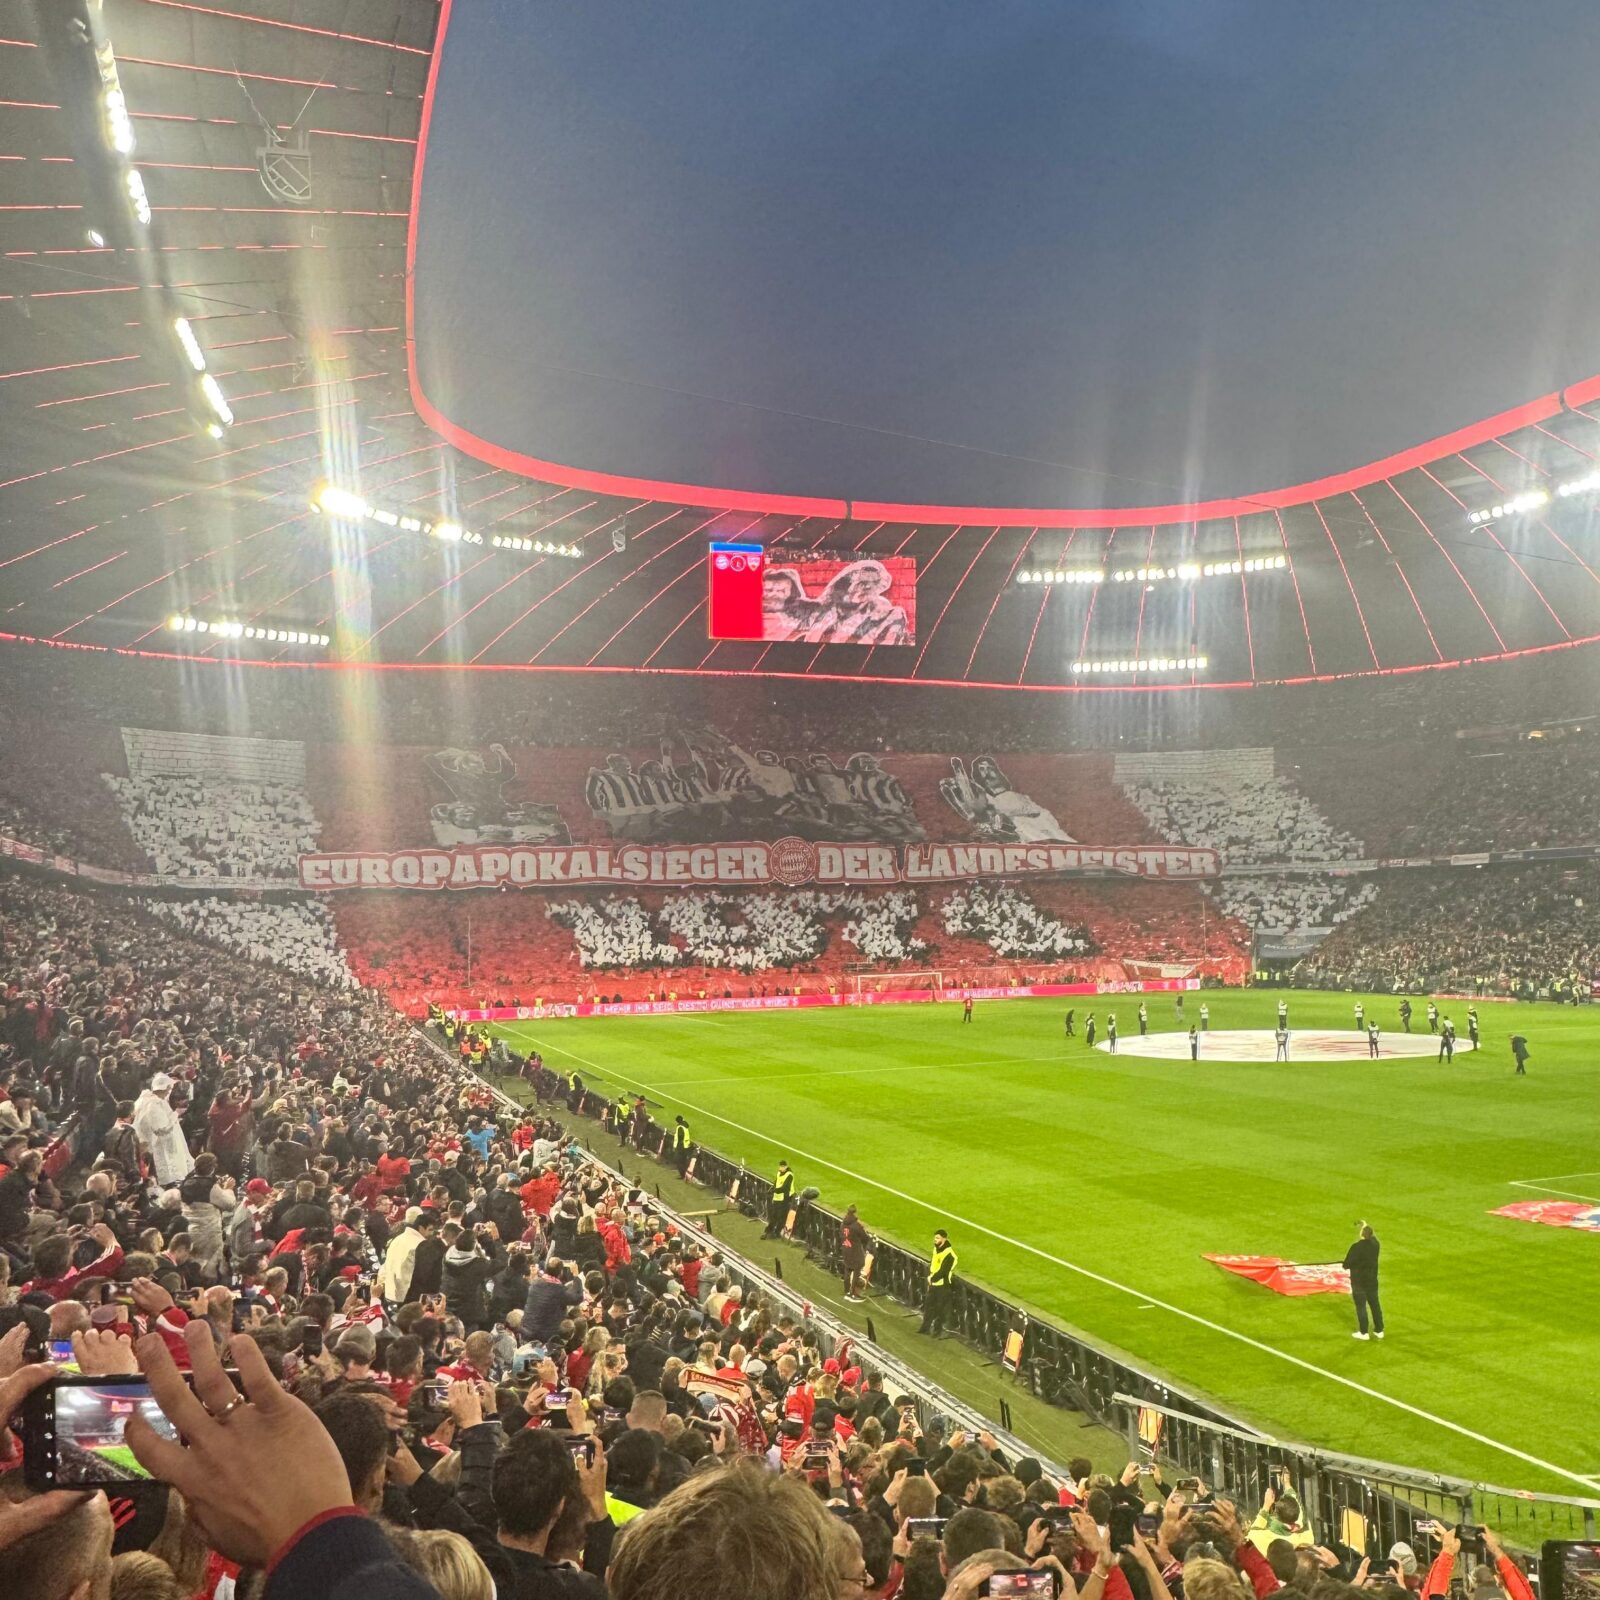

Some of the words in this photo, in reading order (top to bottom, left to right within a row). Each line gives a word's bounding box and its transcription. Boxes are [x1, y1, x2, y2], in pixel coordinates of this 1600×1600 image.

[302, 847, 770, 885] EUROPAPOKALSIEGER
[818, 847, 896, 879] DER
[907, 847, 1217, 877] LANDESMEISTER
